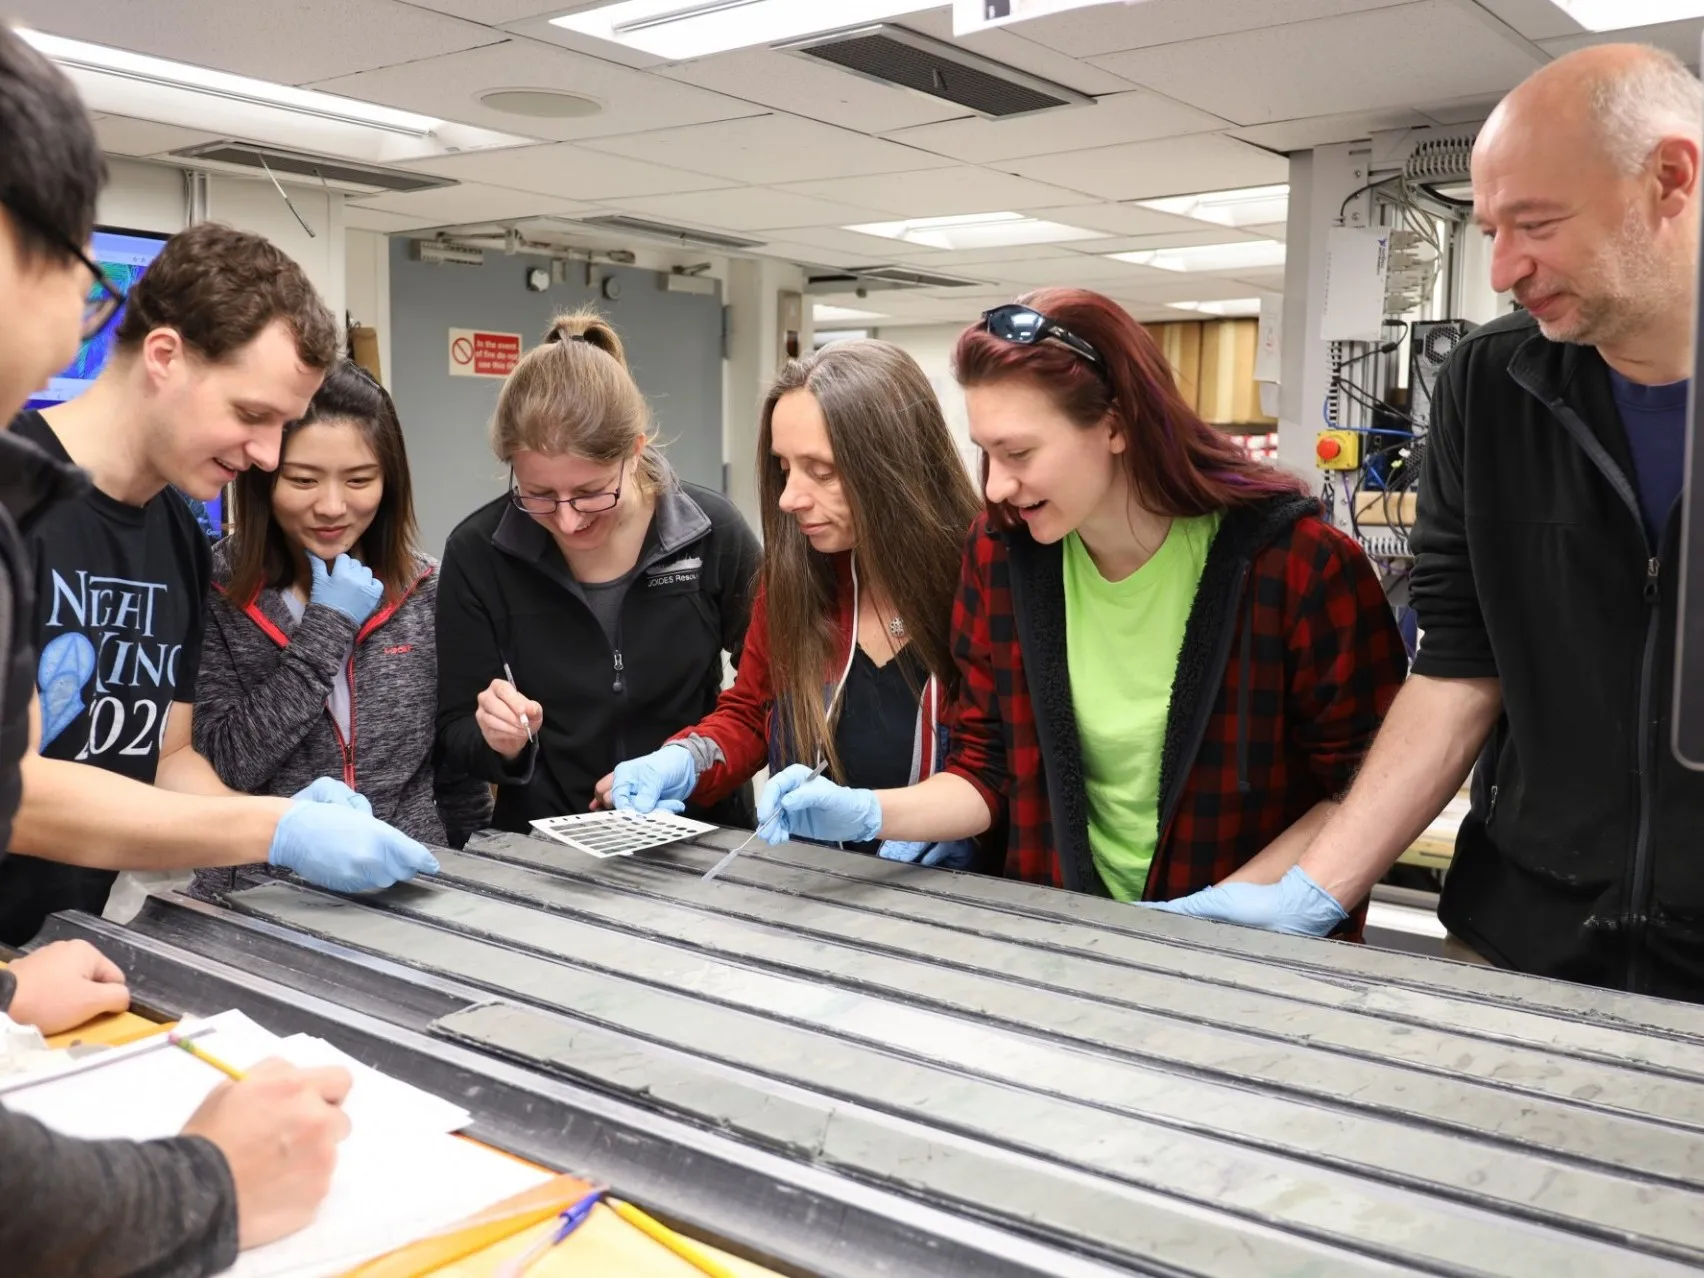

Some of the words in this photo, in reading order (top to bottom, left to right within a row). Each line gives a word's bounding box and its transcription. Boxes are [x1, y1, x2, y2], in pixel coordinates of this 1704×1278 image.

[485, 340, 497, 348] the
[484, 350, 496, 358] fire
[497, 351, 506, 360] do
[492, 361, 505, 369] this
[75, 696, 172, 760] 02
